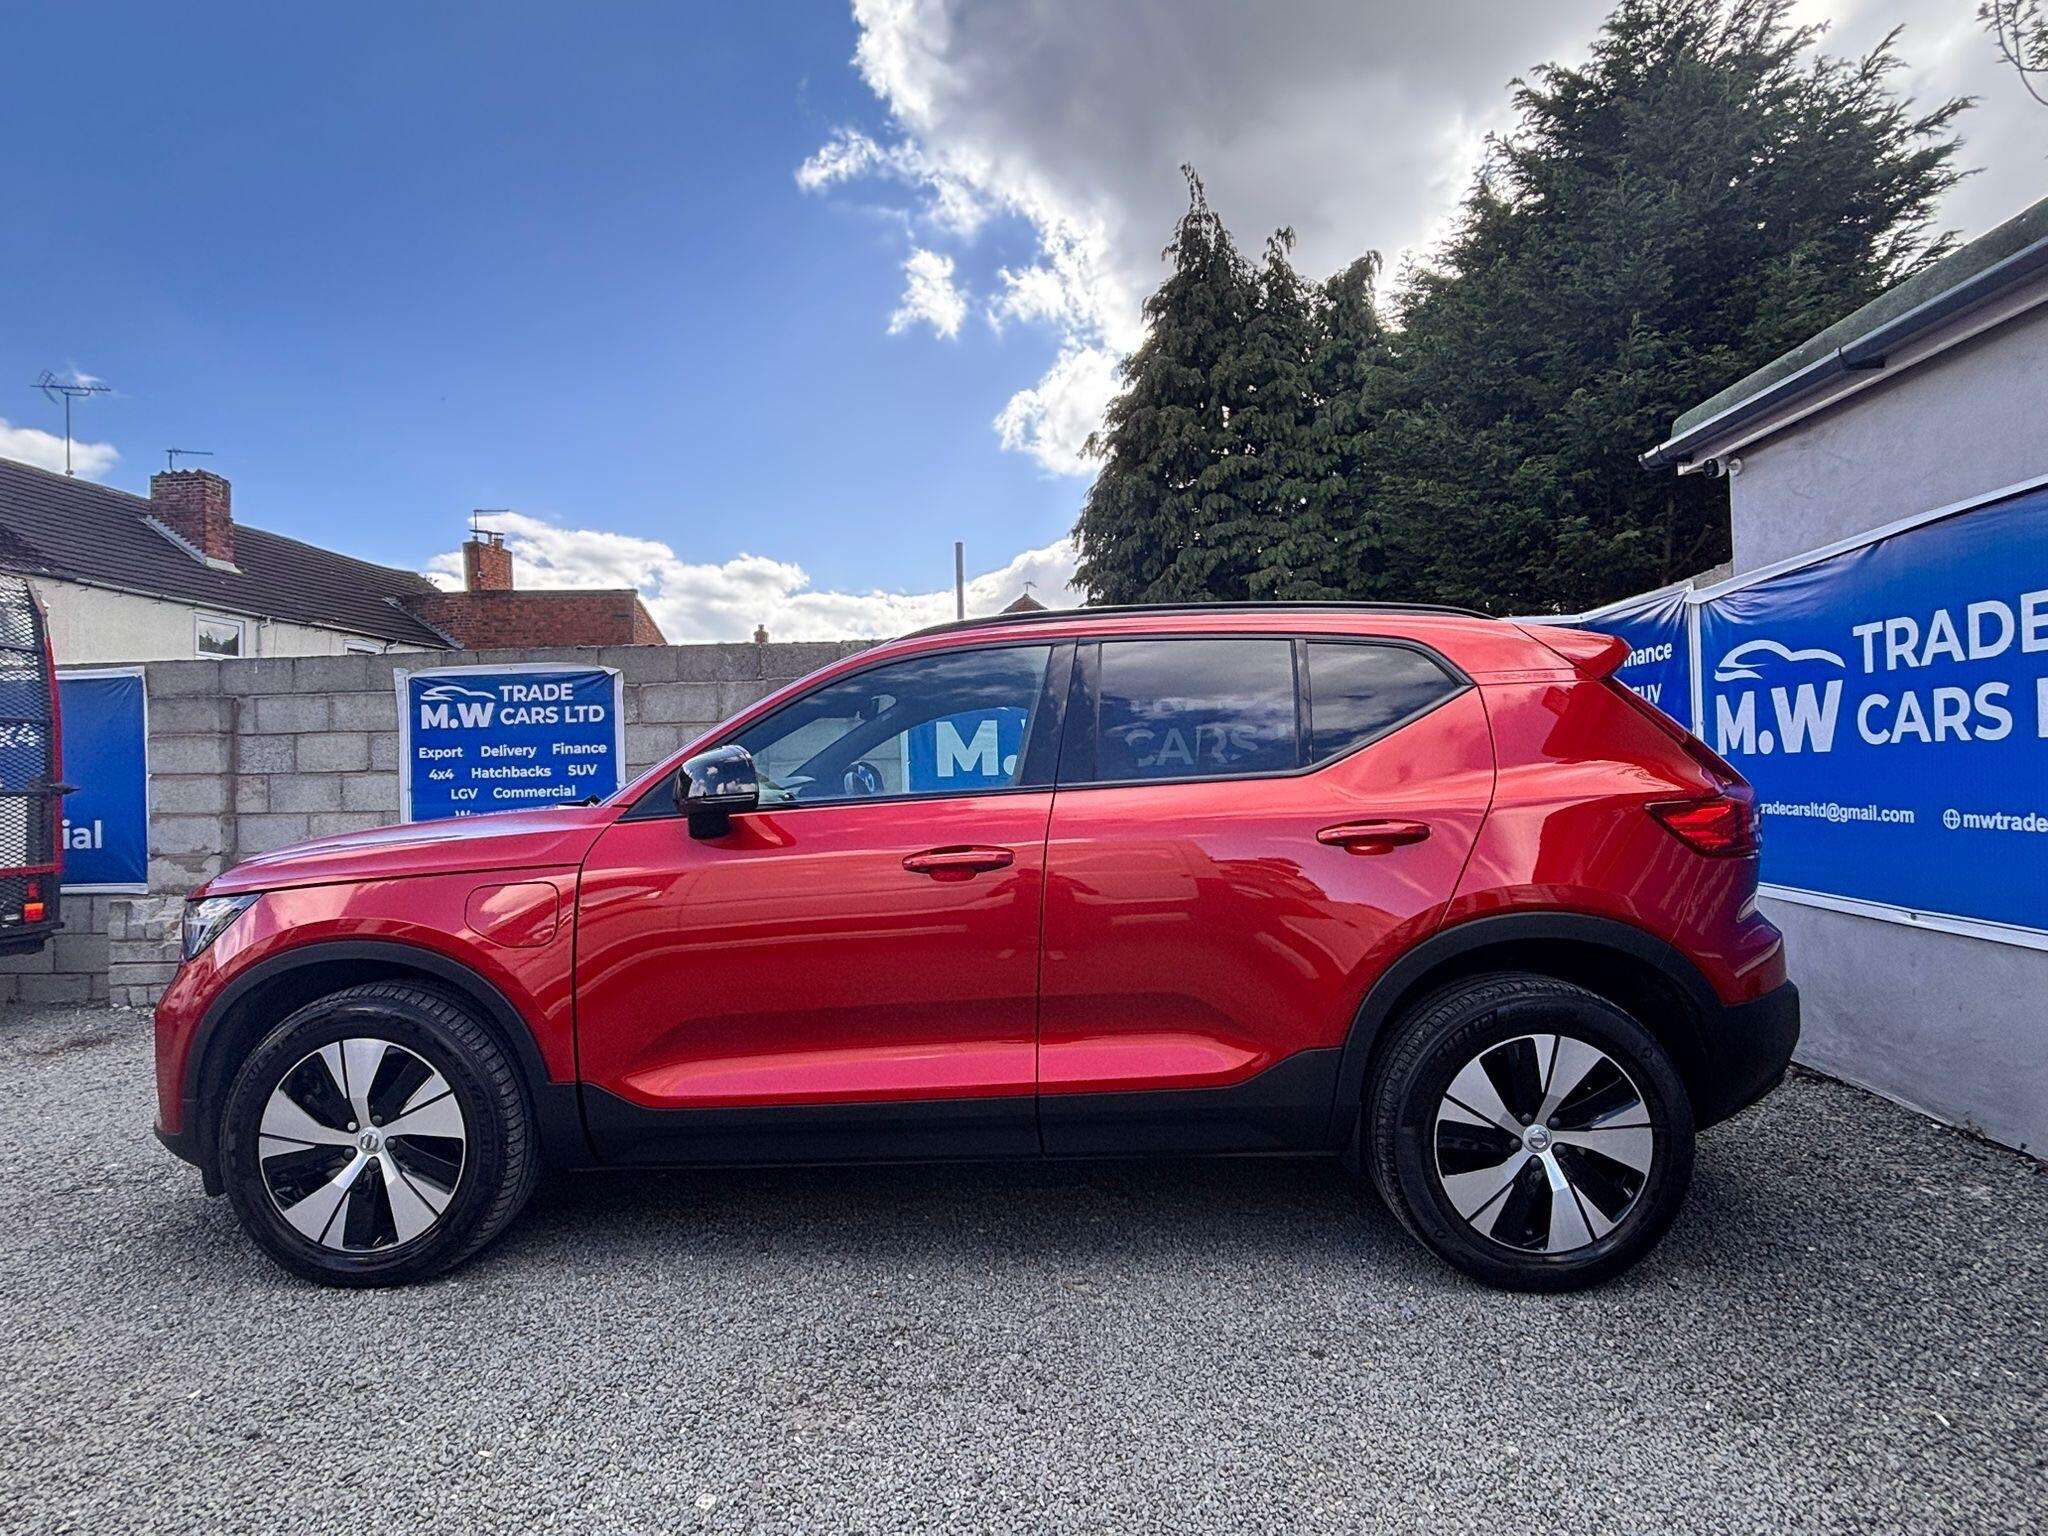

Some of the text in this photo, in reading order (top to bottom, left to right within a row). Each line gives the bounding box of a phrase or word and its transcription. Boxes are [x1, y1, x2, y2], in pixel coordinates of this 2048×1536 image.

[1852, 589, 2048, 673] TRADE
[499, 683, 573, 702] TRADE
[421, 702, 495, 729] M.W
[500, 705, 605, 725] CARS LTD
[1716, 679, 1844, 756] M.W
[1857, 681, 2013, 745] CARS
[419, 742, 607, 760] Export Delivery Finance
[472, 765, 551, 779] Hatchbacks
[568, 764, 598, 776] SUV
[451, 785, 576, 800] LGV Commercial
[1963, 811, 2048, 832] mwtrade
[62, 819, 103, 849] ial
